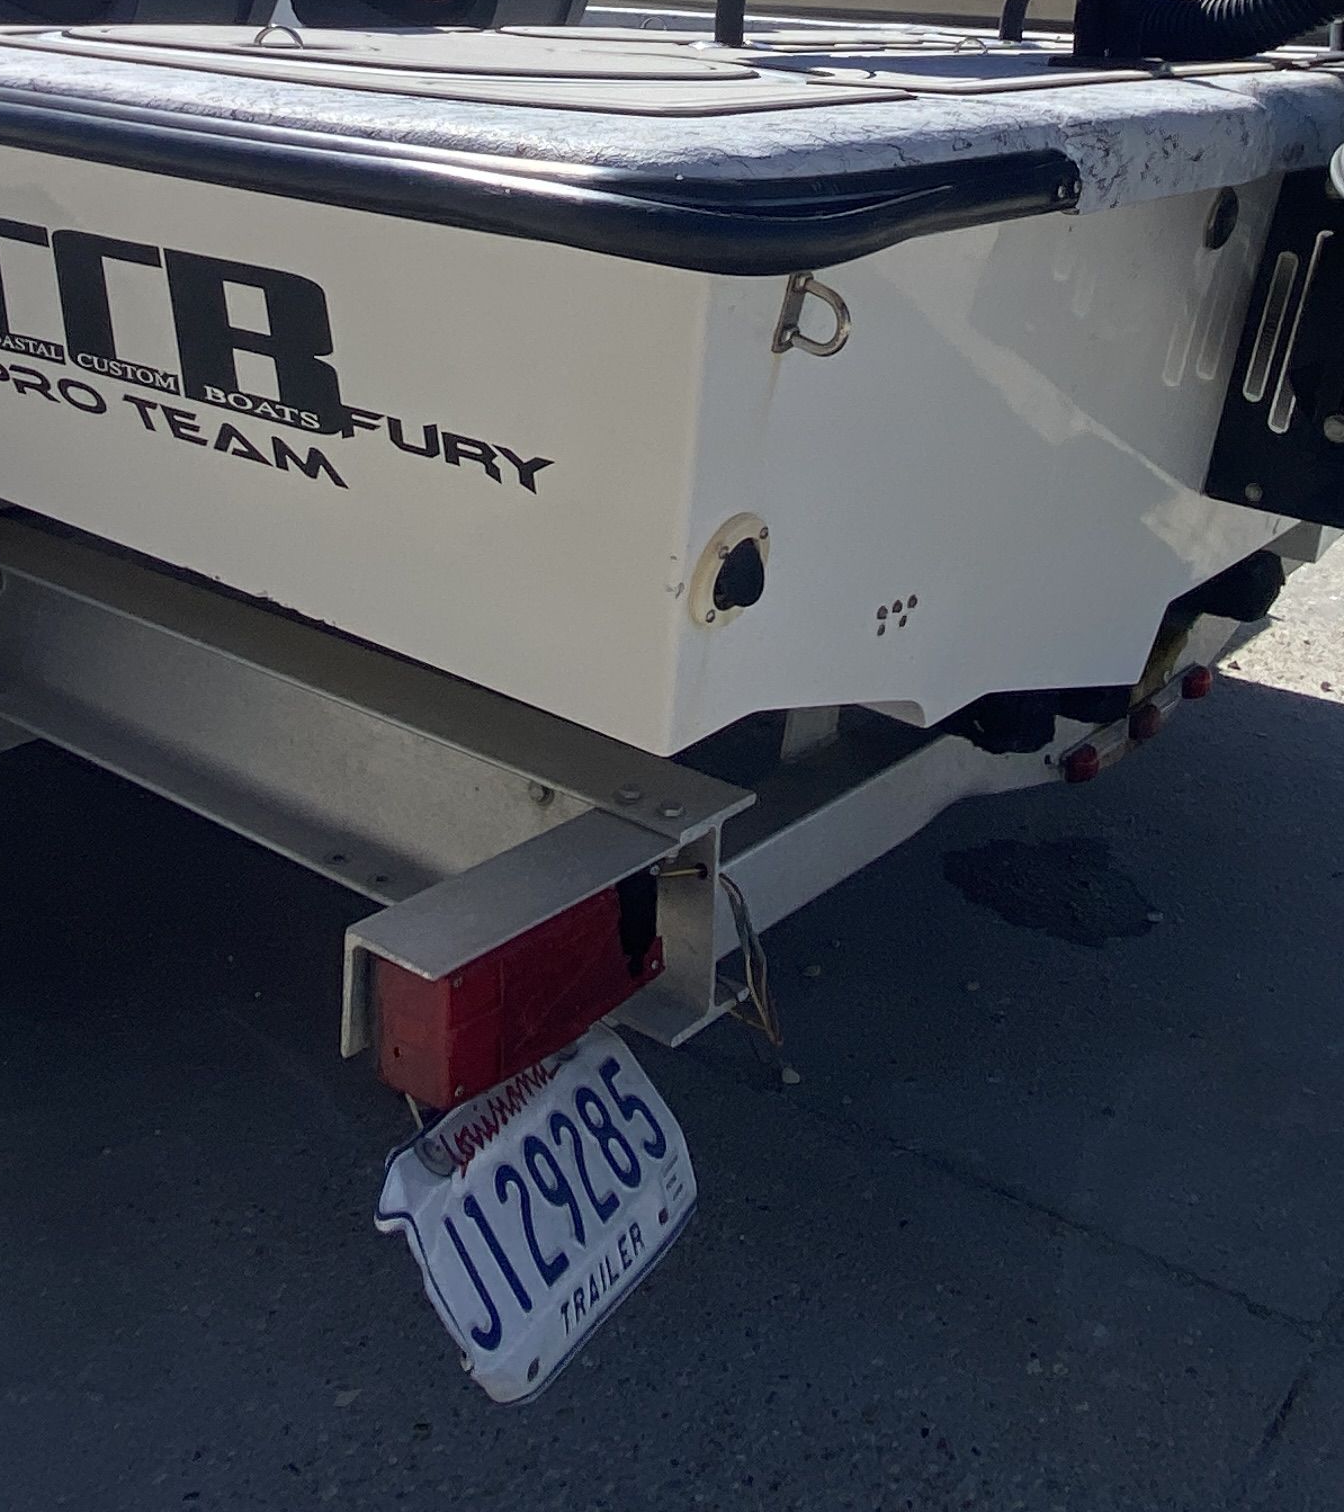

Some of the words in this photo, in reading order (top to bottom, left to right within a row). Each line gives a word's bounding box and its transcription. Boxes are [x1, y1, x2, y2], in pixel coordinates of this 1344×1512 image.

[76, 351, 178, 393] CUSTOM
[202, 384, 321, 431] BOATS
[122, 393, 350, 490] TEAM
[340, 403, 555, 495] FURY
[442, 1057, 667, 1351] J129285
[559, 1223, 647, 1336] TRAILER
